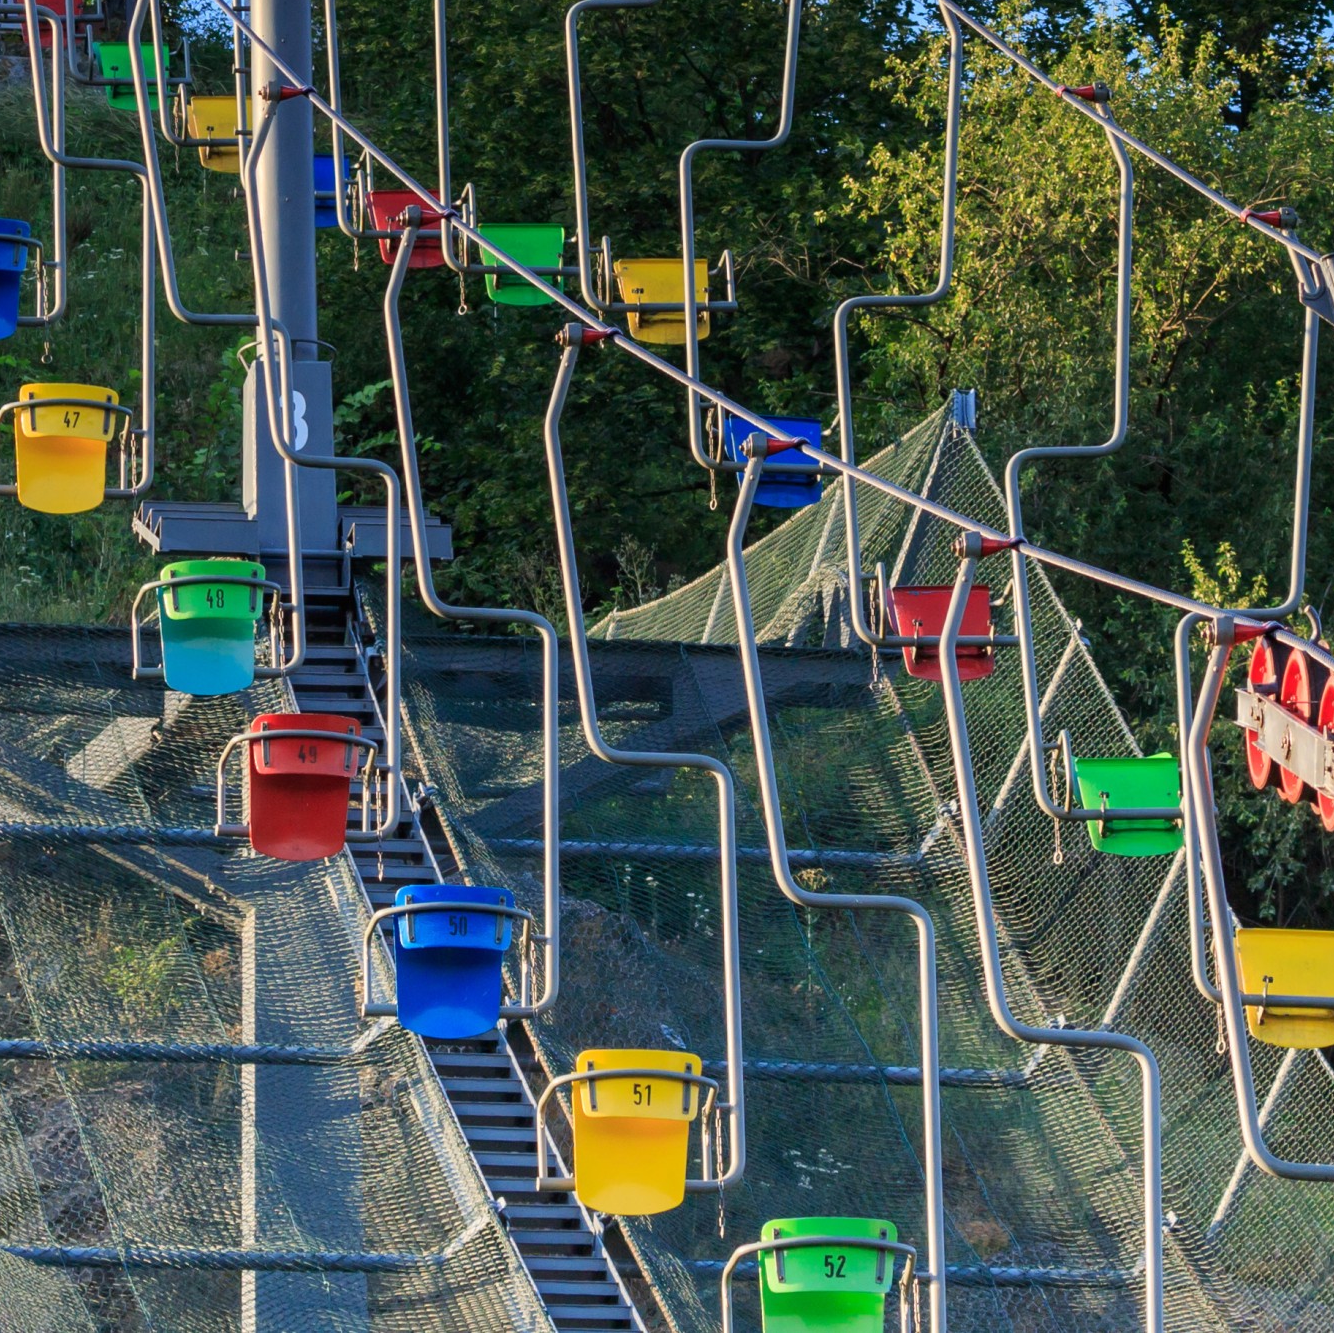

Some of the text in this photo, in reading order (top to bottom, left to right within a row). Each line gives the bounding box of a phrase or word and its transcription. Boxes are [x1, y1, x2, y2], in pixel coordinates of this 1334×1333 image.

[63, 411, 80, 428] 47
[279, 390, 309, 452] 3
[205, 588, 224, 609] 48
[298, 744, 317, 764] 49
[449, 915, 468, 936] 50
[633, 1083, 651, 1106] 51
[824, 1254, 846, 1278] 52
